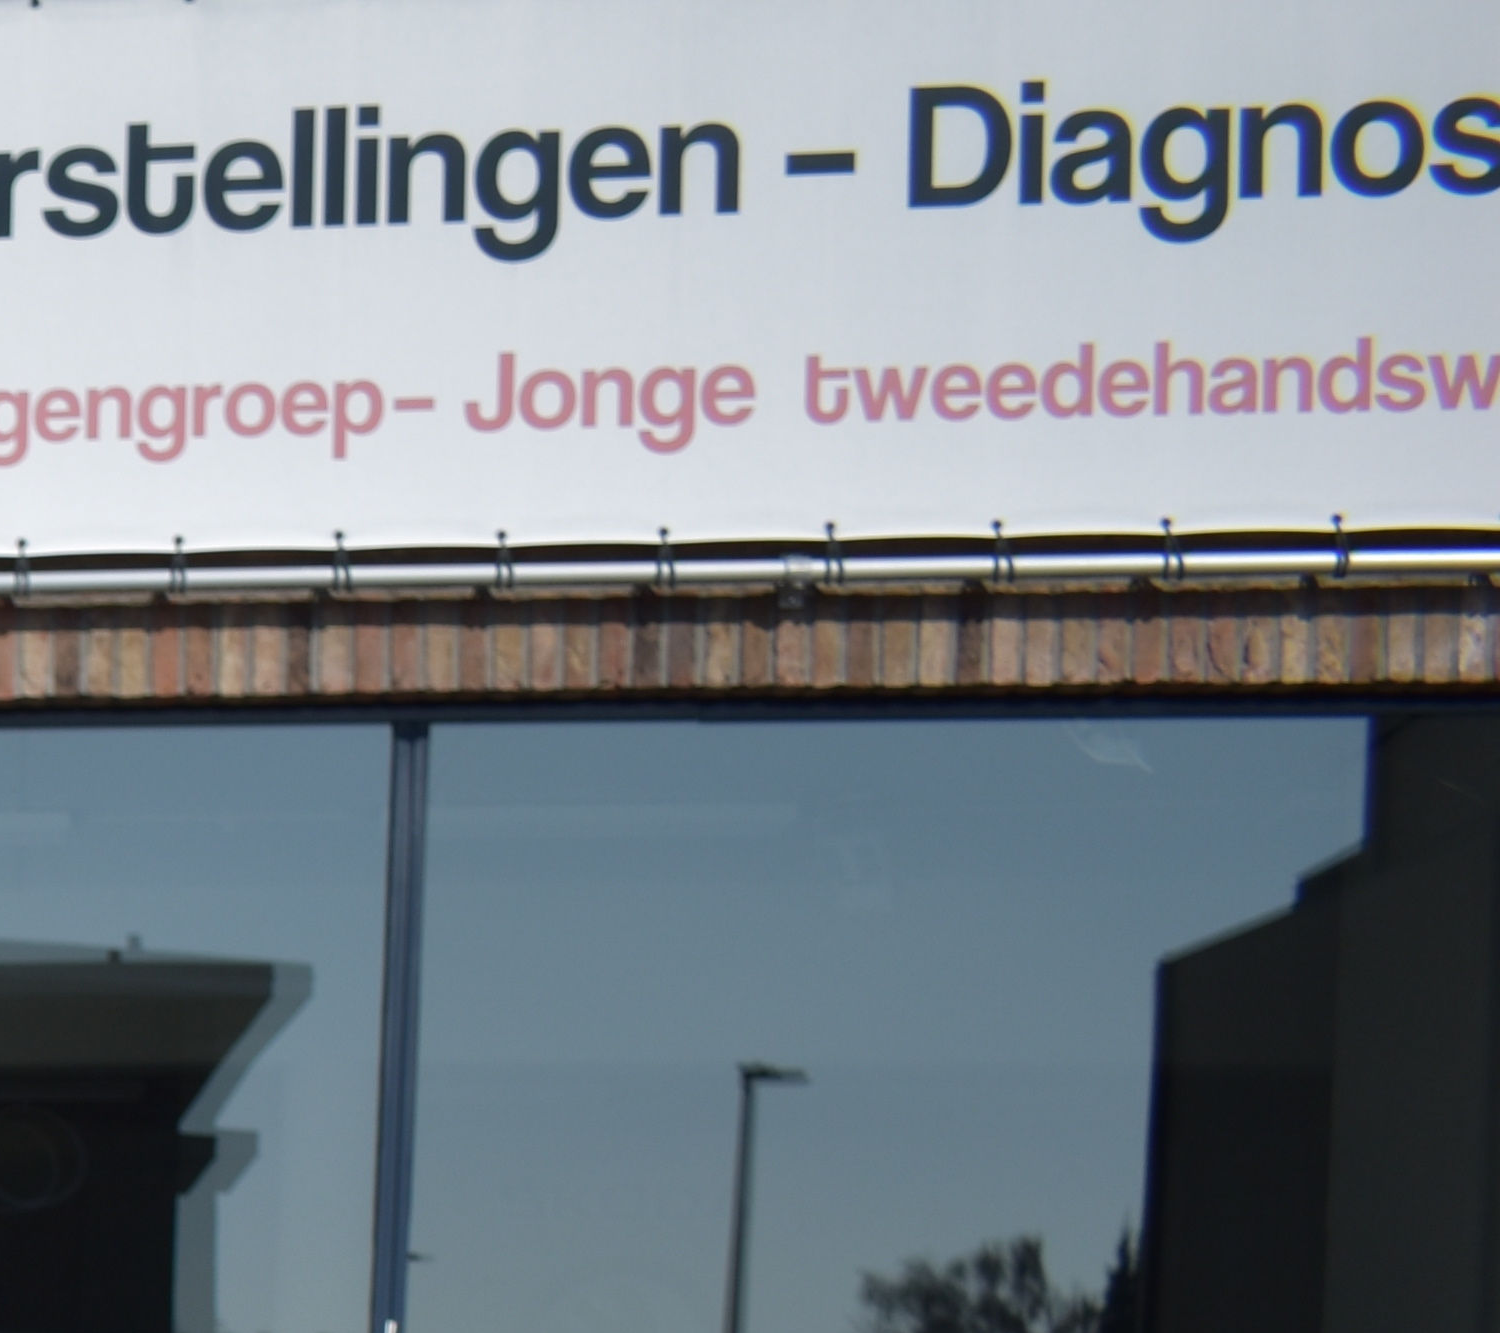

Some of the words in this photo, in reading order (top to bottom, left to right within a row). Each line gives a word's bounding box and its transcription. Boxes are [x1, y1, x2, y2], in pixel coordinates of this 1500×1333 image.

[908, 80, 1500, 244] Diagnos
[464, 352, 758, 454] Jonge
[804, 335, 1500, 425] tweedehandsw
